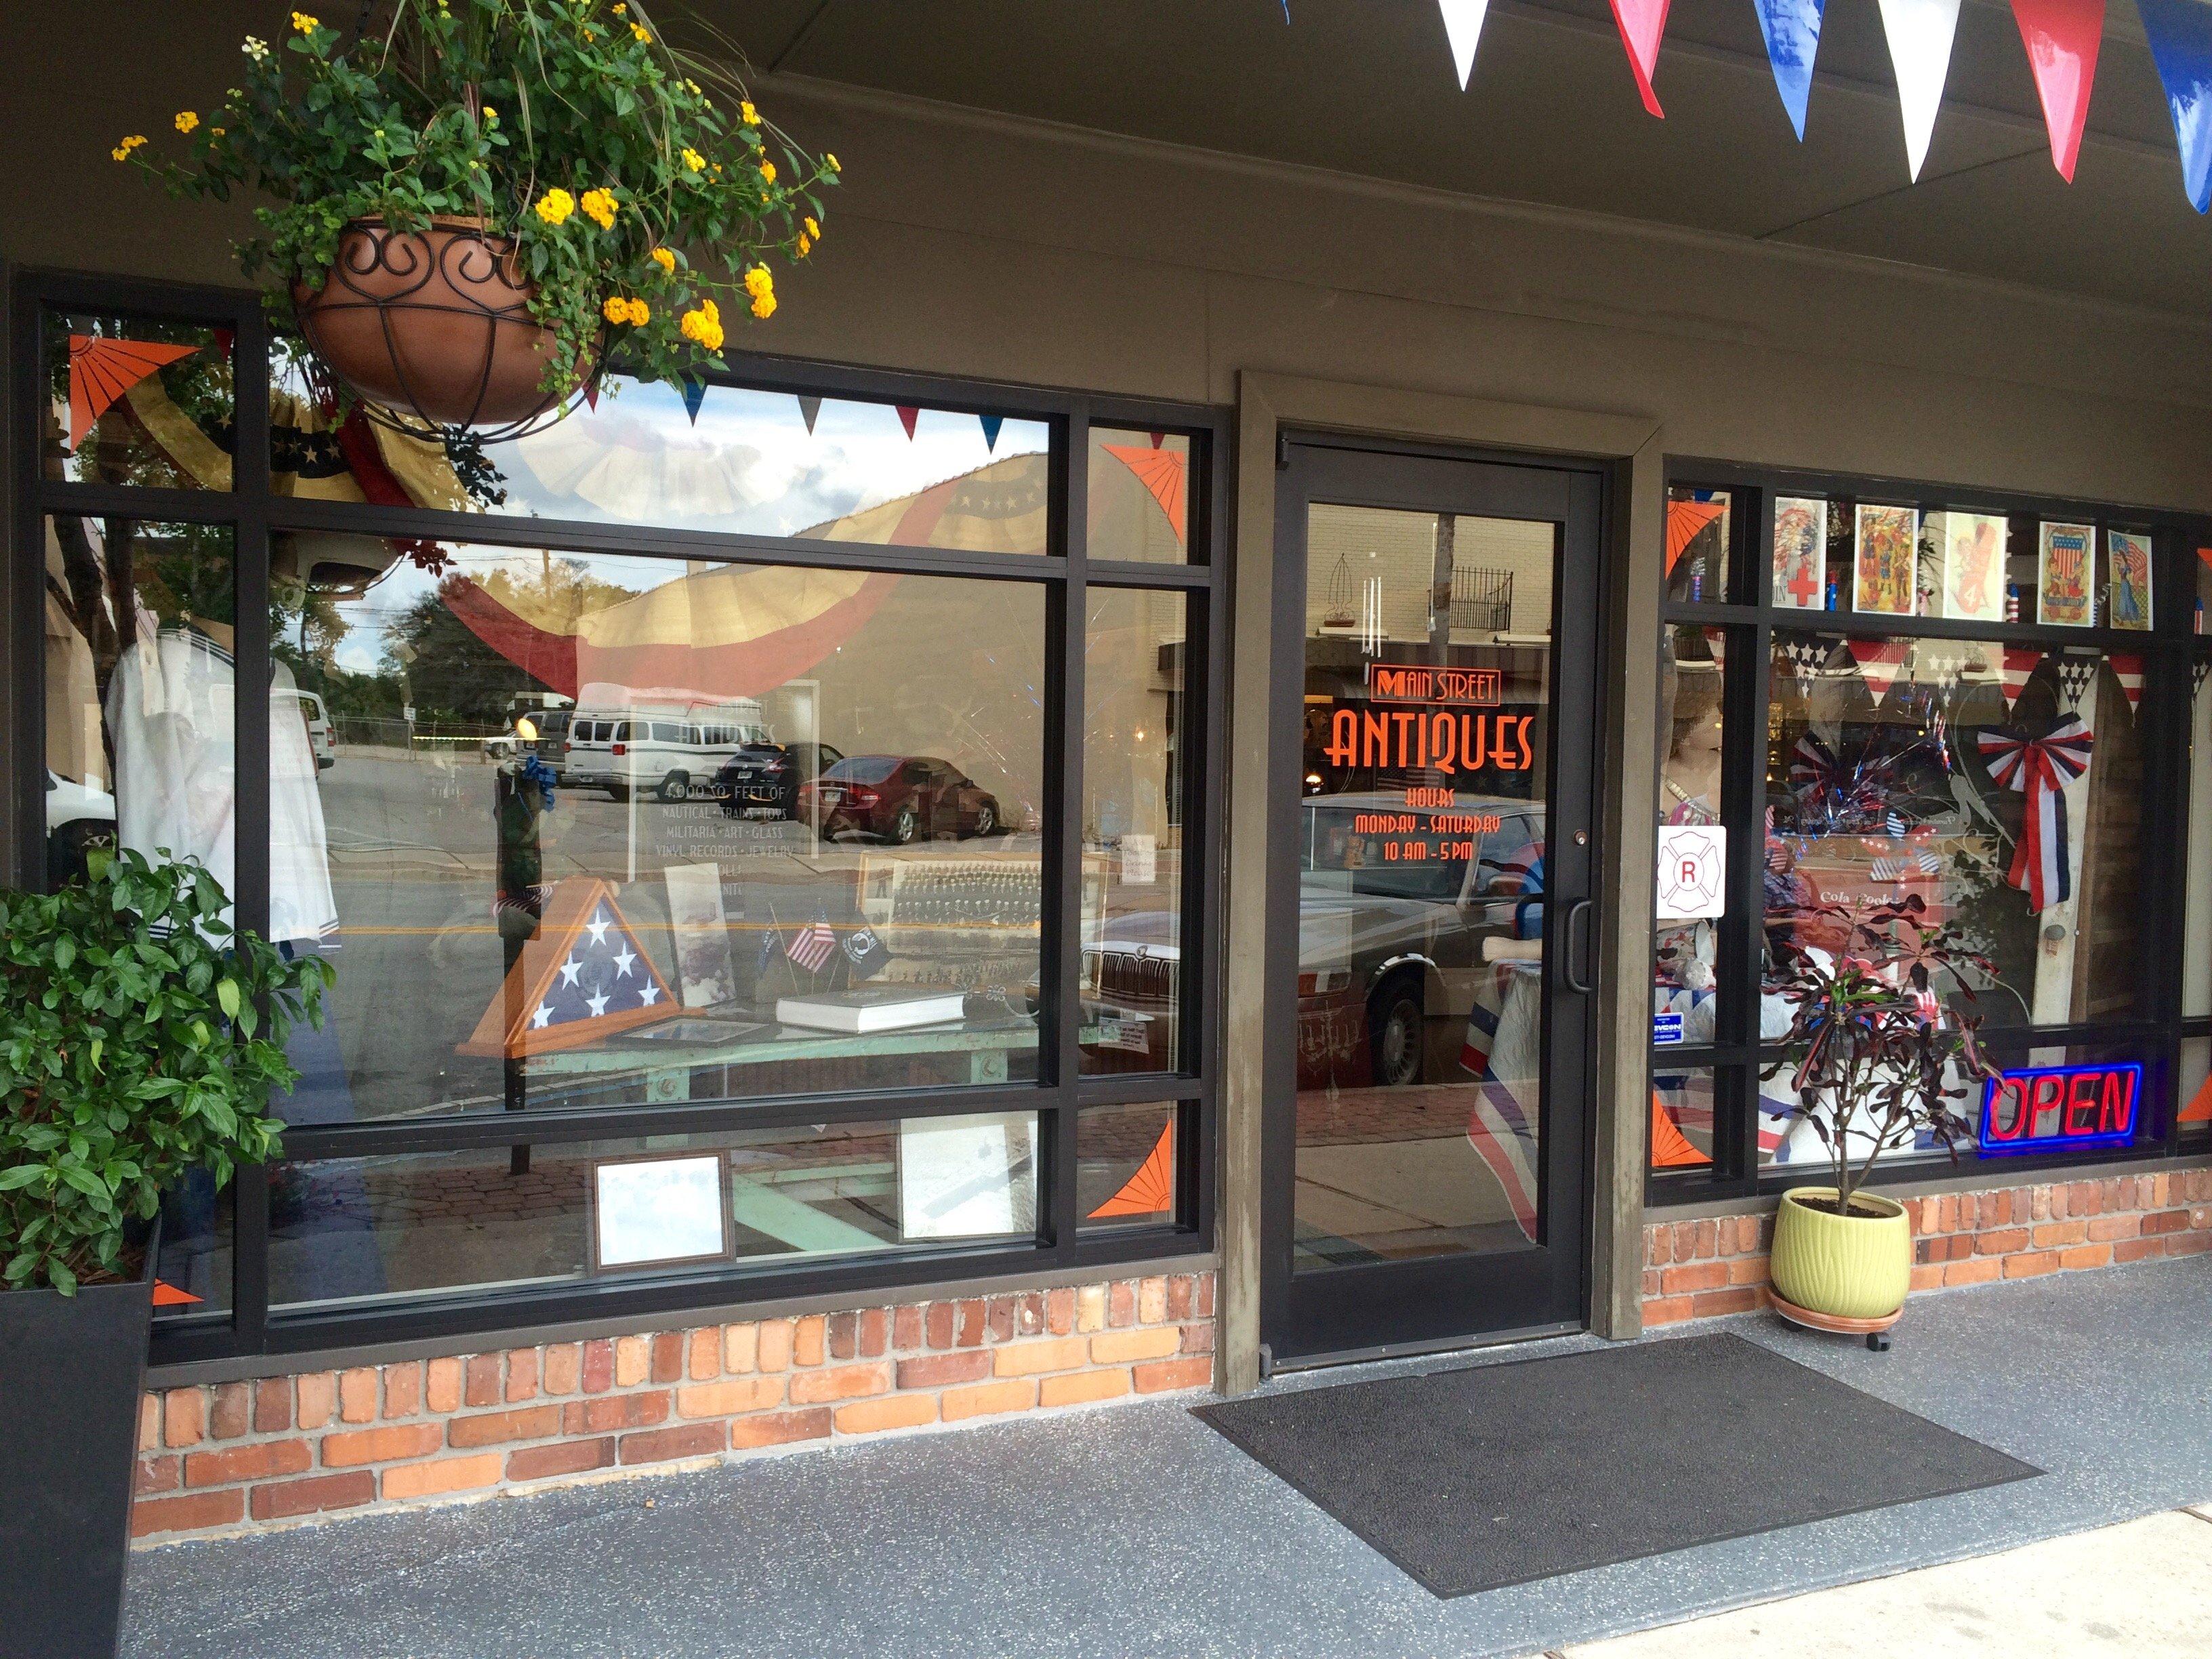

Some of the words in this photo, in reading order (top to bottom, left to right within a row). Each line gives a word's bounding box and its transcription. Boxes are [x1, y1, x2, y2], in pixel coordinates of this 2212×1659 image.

[1376, 670, 1432, 697] MAIN
[1435, 672, 1495, 700] STREET
[1324, 710, 1534, 775] ANTIQUES
[735, 786, 764, 800] FEET
[769, 786, 785, 800] OF
[1405, 788, 1455, 807] HOURS
[662, 804, 712, 819] NAUTICAL
[720, 806, 754, 819] TRAINS
[762, 807, 787, 820] TOYS
[666, 825, 716, 838] MILITARIA
[724, 826, 743, 839] ART
[752, 826, 783, 839] GLASS
[1355, 815, 1416, 834] MONDAY
[1430, 815, 1501, 834] SATURDAY
[655, 844, 685, 857] VINYL
[689, 844, 737, 858] RECORDS
[1384, 842, 1399, 861] 10
[1402, 842, 1427, 861] AM
[1440, 842, 1449, 860] 5
[1452, 842, 1473, 860] PM
[1682, 861, 1696, 882] R
[1820, 891, 1850, 903] Cola
[1990, 1071, 2134, 1141] OPEN
